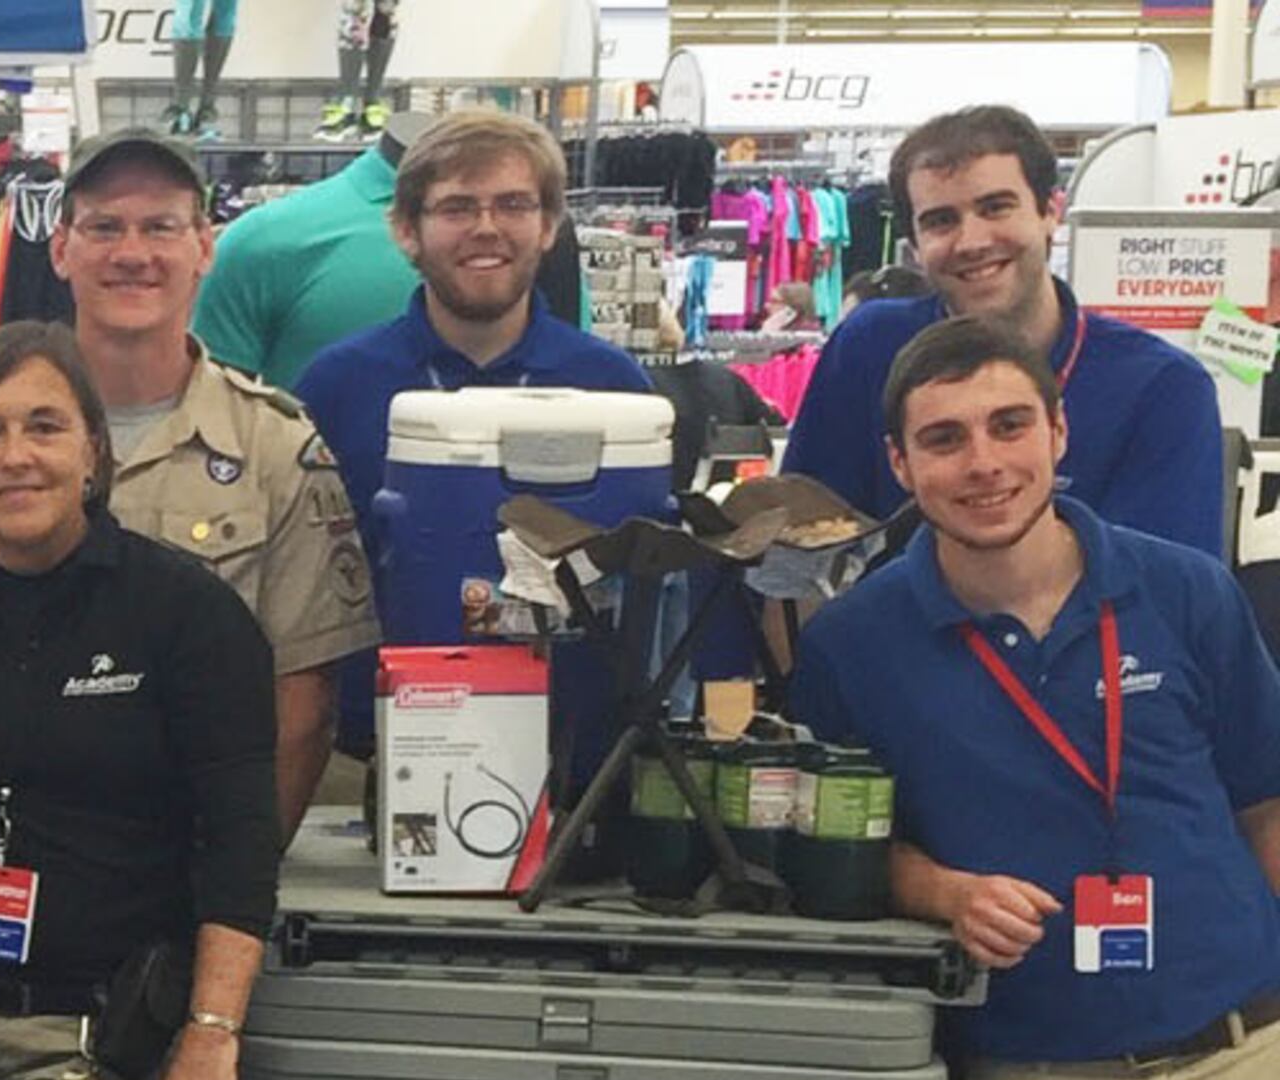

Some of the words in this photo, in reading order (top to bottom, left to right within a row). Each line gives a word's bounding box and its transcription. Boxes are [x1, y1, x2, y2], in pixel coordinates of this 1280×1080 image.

[784, 67, 872, 109] bcg
[1120, 238, 1175, 255] RIGHT
[1180, 238, 1226, 254] STUFF
[1117, 258, 1161, 275] LOW
[1169, 258, 1226, 276] PRICE
[1116, 279, 1225, 297] EVERYDAY!
